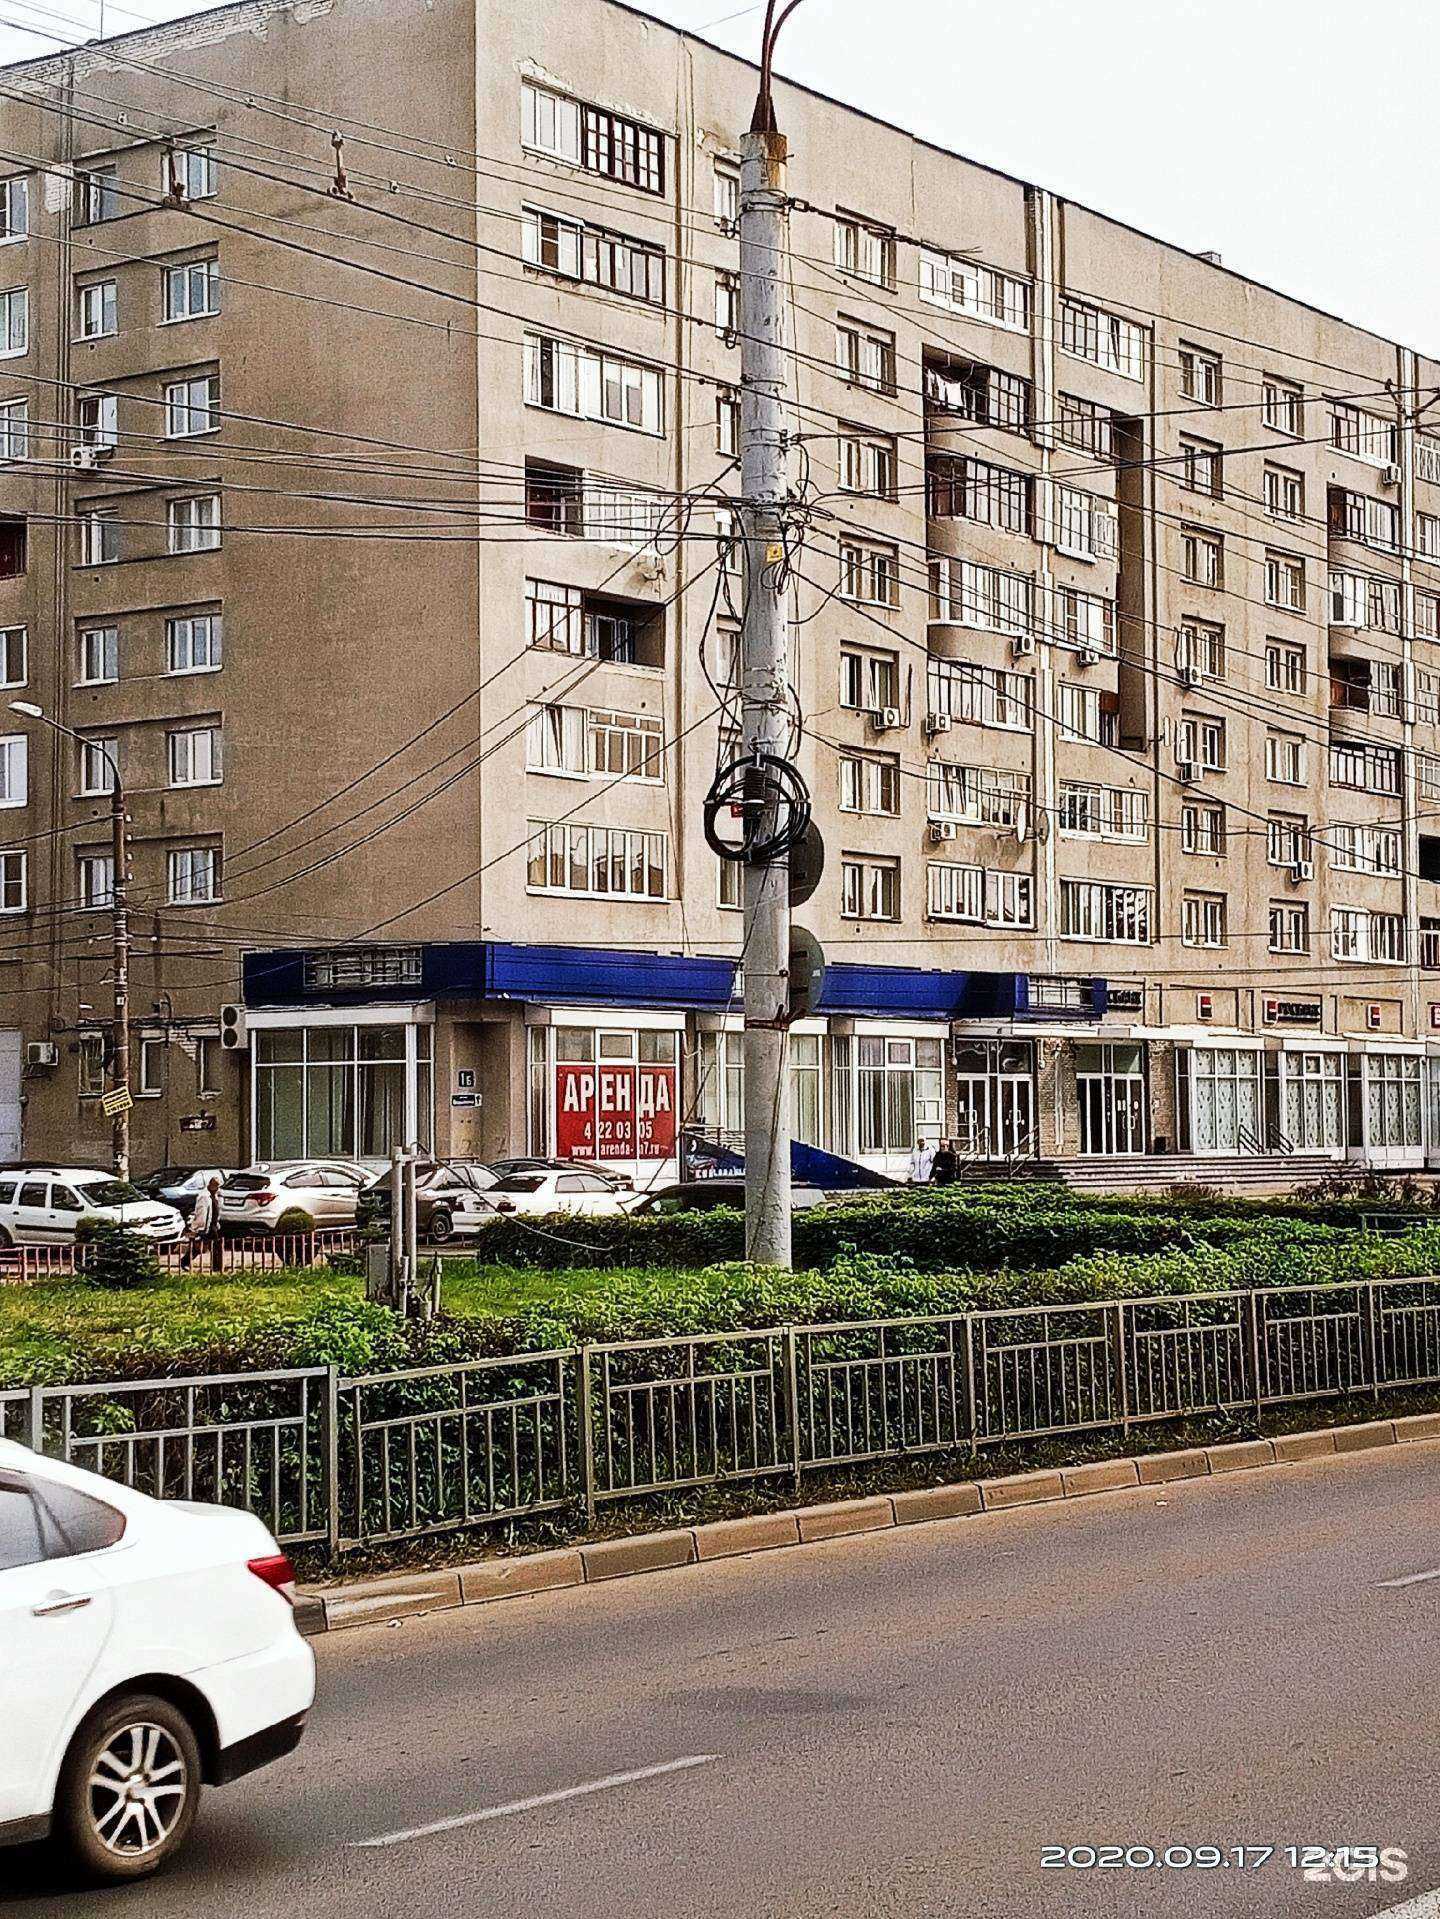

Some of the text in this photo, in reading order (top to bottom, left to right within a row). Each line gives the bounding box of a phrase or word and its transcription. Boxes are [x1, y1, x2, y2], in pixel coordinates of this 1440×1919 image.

[563, 1073, 671, 1118] АРЕНДА
[584, 1121, 591, 1139] 4
[616, 1121, 631, 1139] 03
